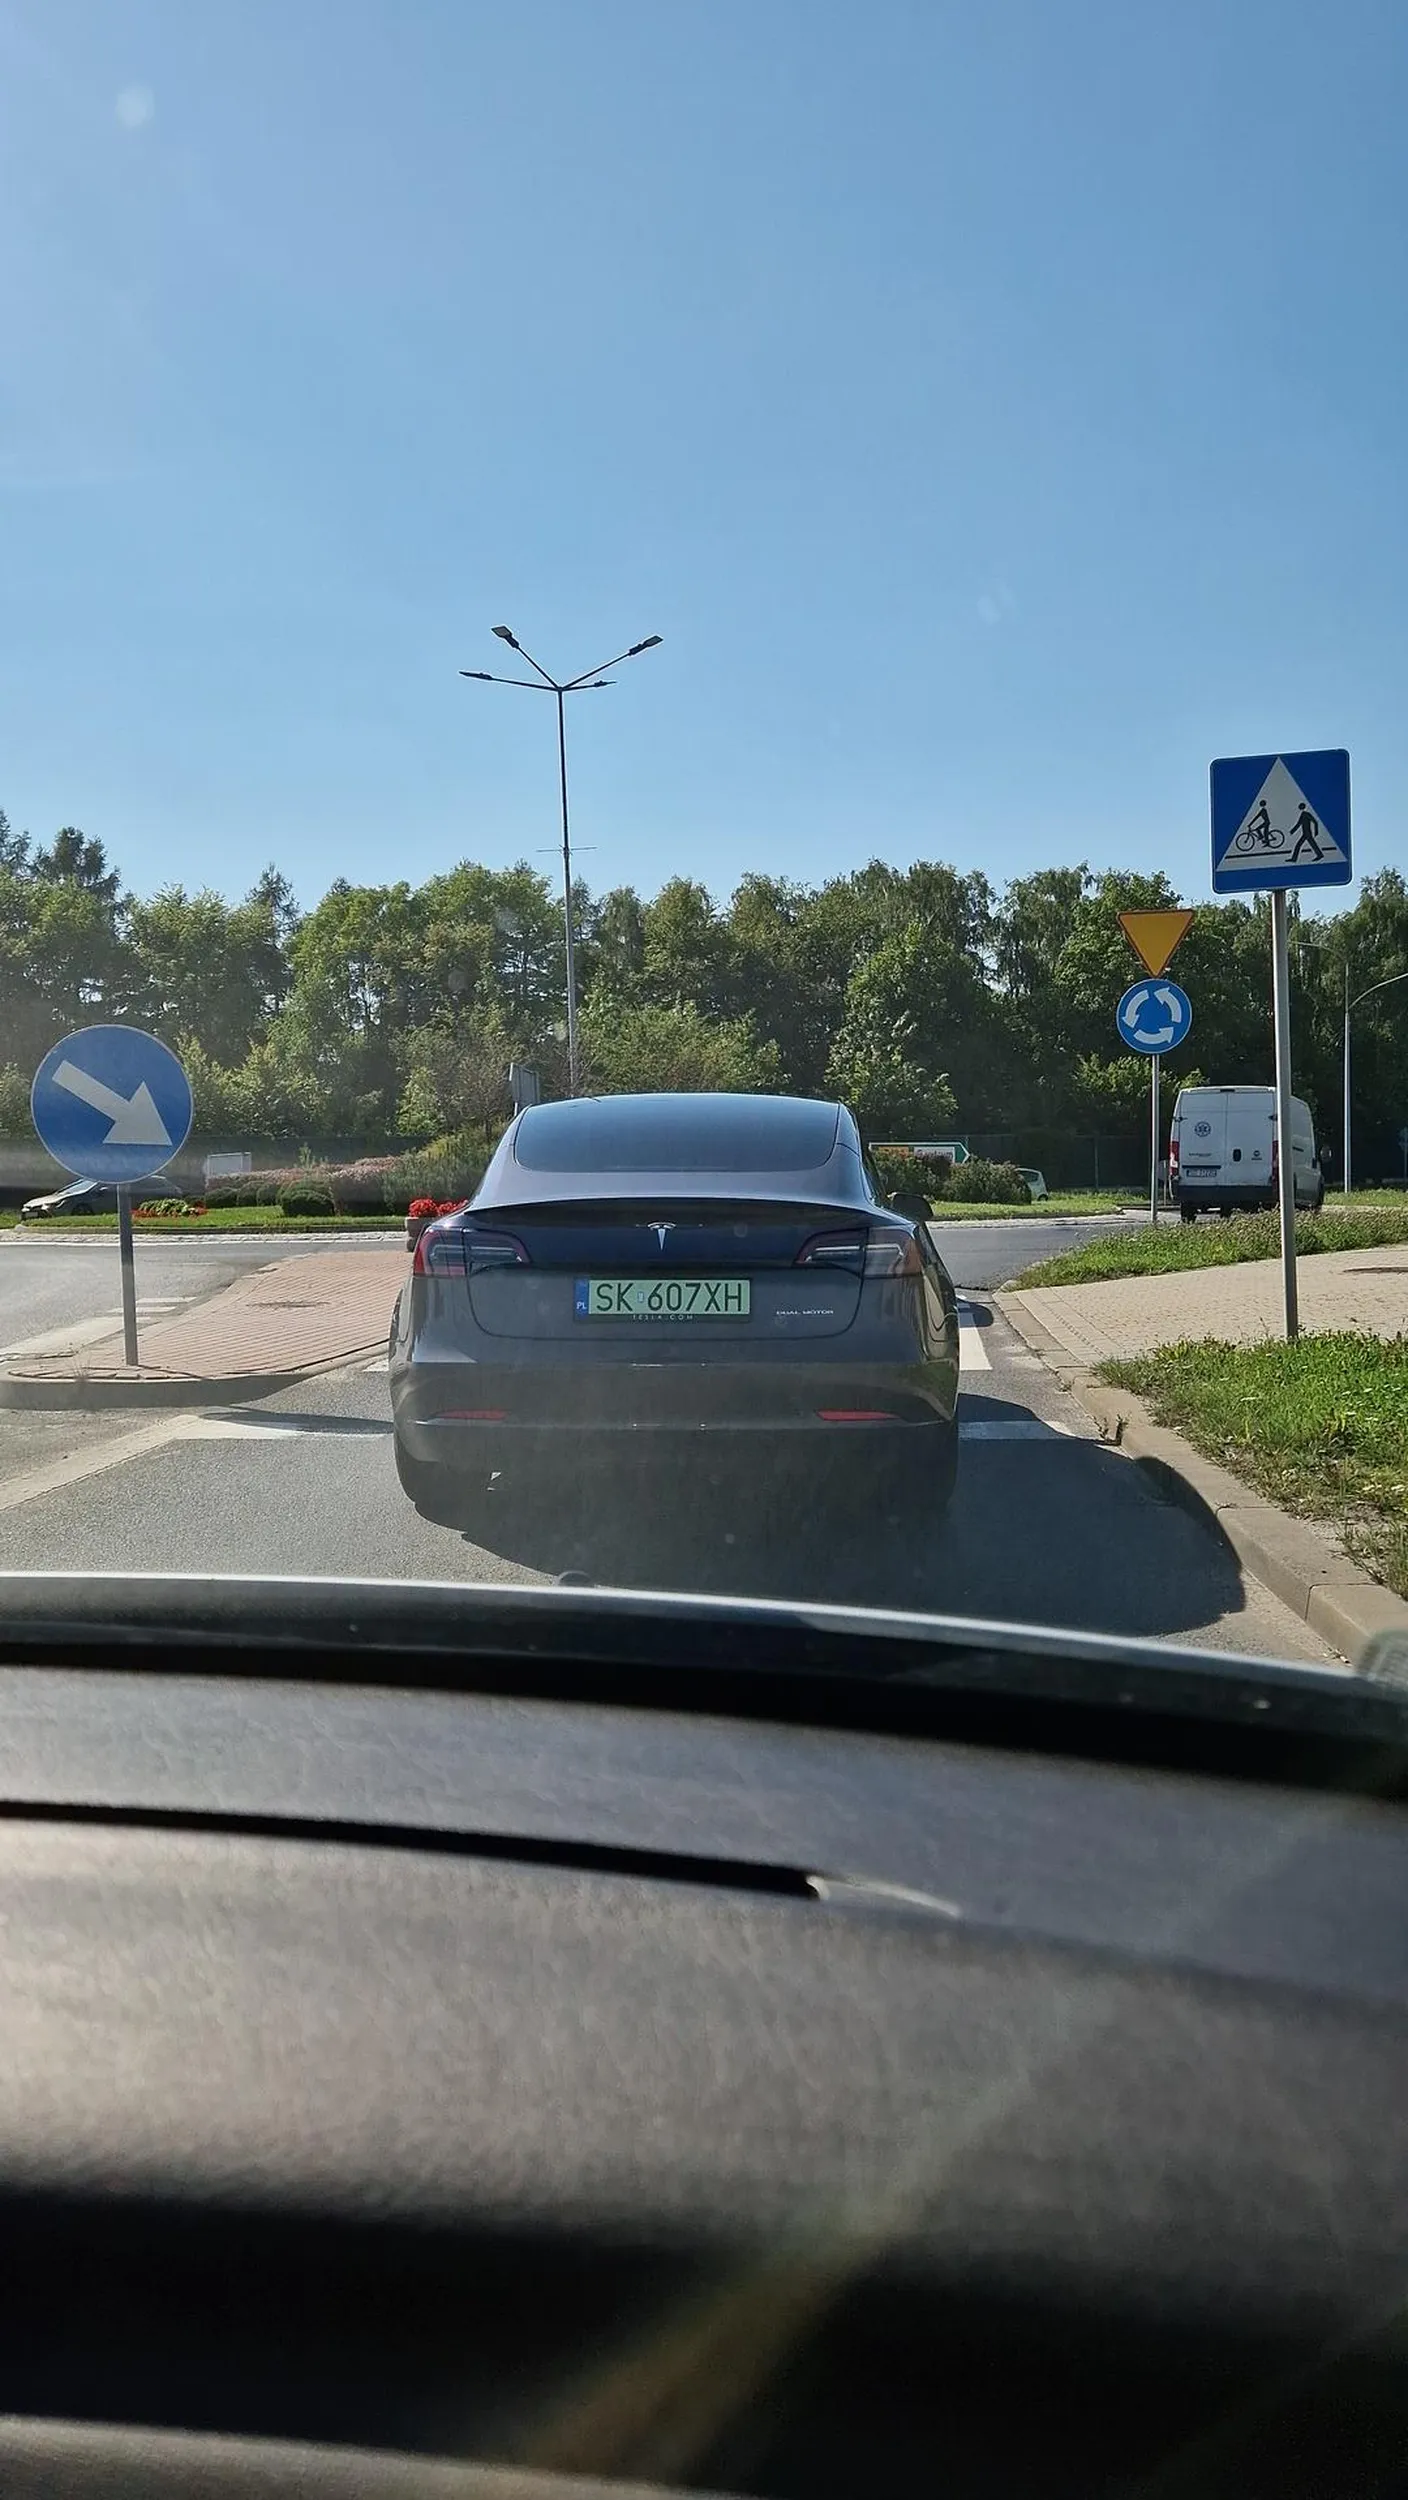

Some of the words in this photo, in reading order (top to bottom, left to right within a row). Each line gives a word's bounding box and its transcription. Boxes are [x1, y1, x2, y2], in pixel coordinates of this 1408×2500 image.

[576, 1302, 587, 1310] PL
[596, 1283, 633, 1311] SK
[648, 1283, 741, 1311] 607XH
